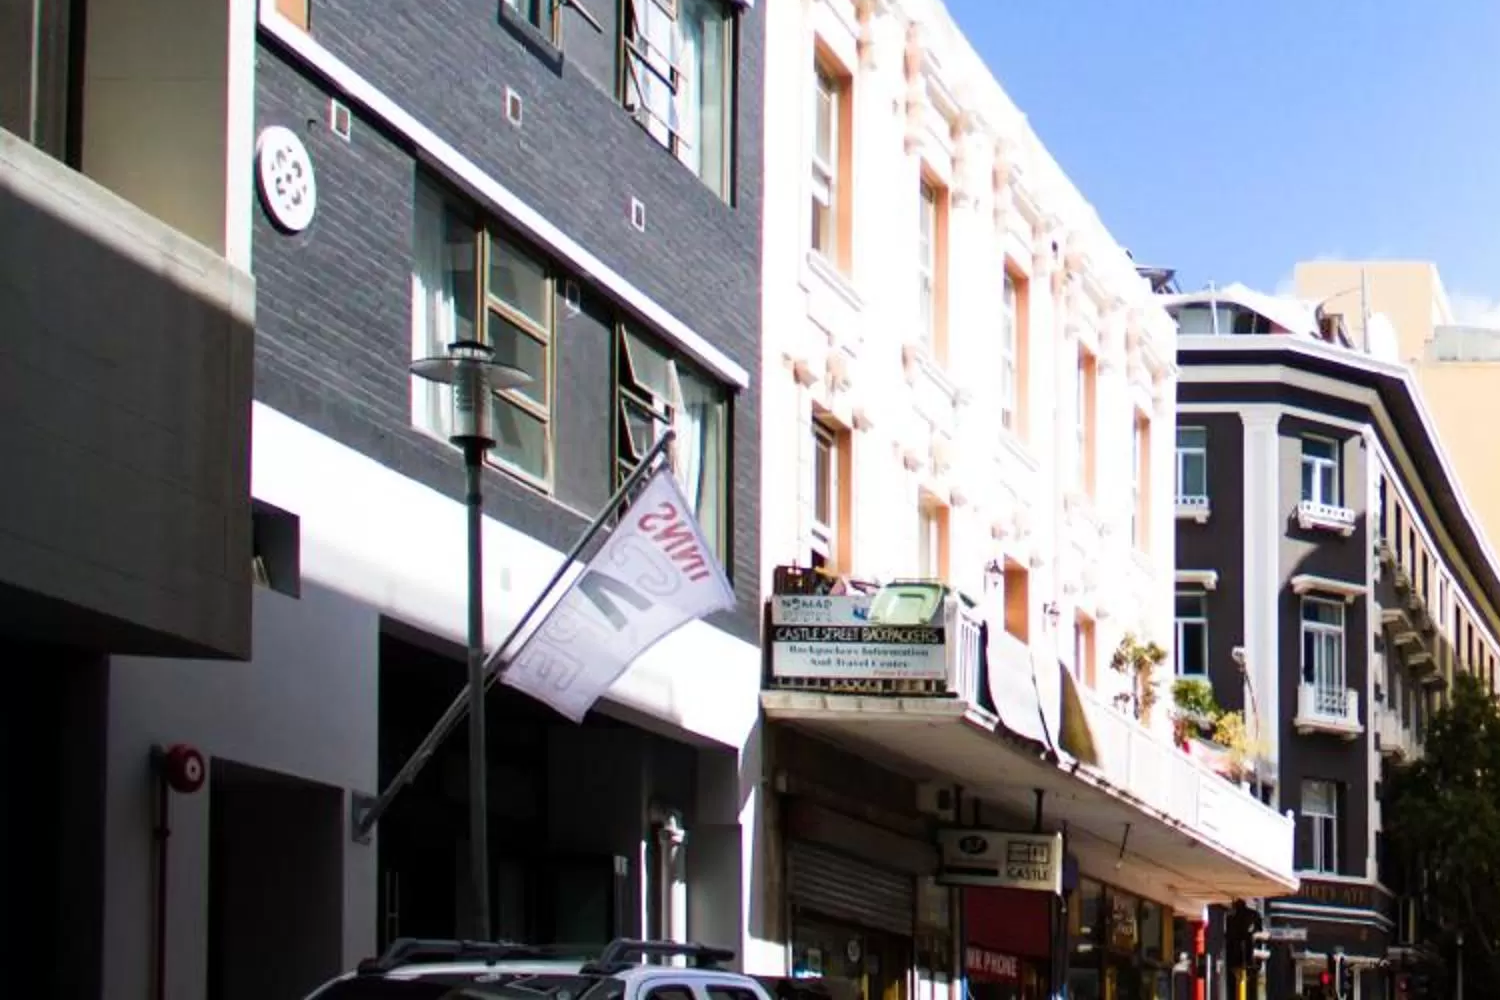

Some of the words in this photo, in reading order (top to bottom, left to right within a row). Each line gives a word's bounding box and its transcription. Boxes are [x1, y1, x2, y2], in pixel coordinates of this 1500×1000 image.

[781, 598, 833, 611] NOMAD
[776, 627, 818, 641] CASTLE
[820, 628, 859, 641] STREET
[862, 628, 938, 642] BACKPACKERS
[861, 645, 929, 657] Information
[984, 951, 1017, 978] PHONE
